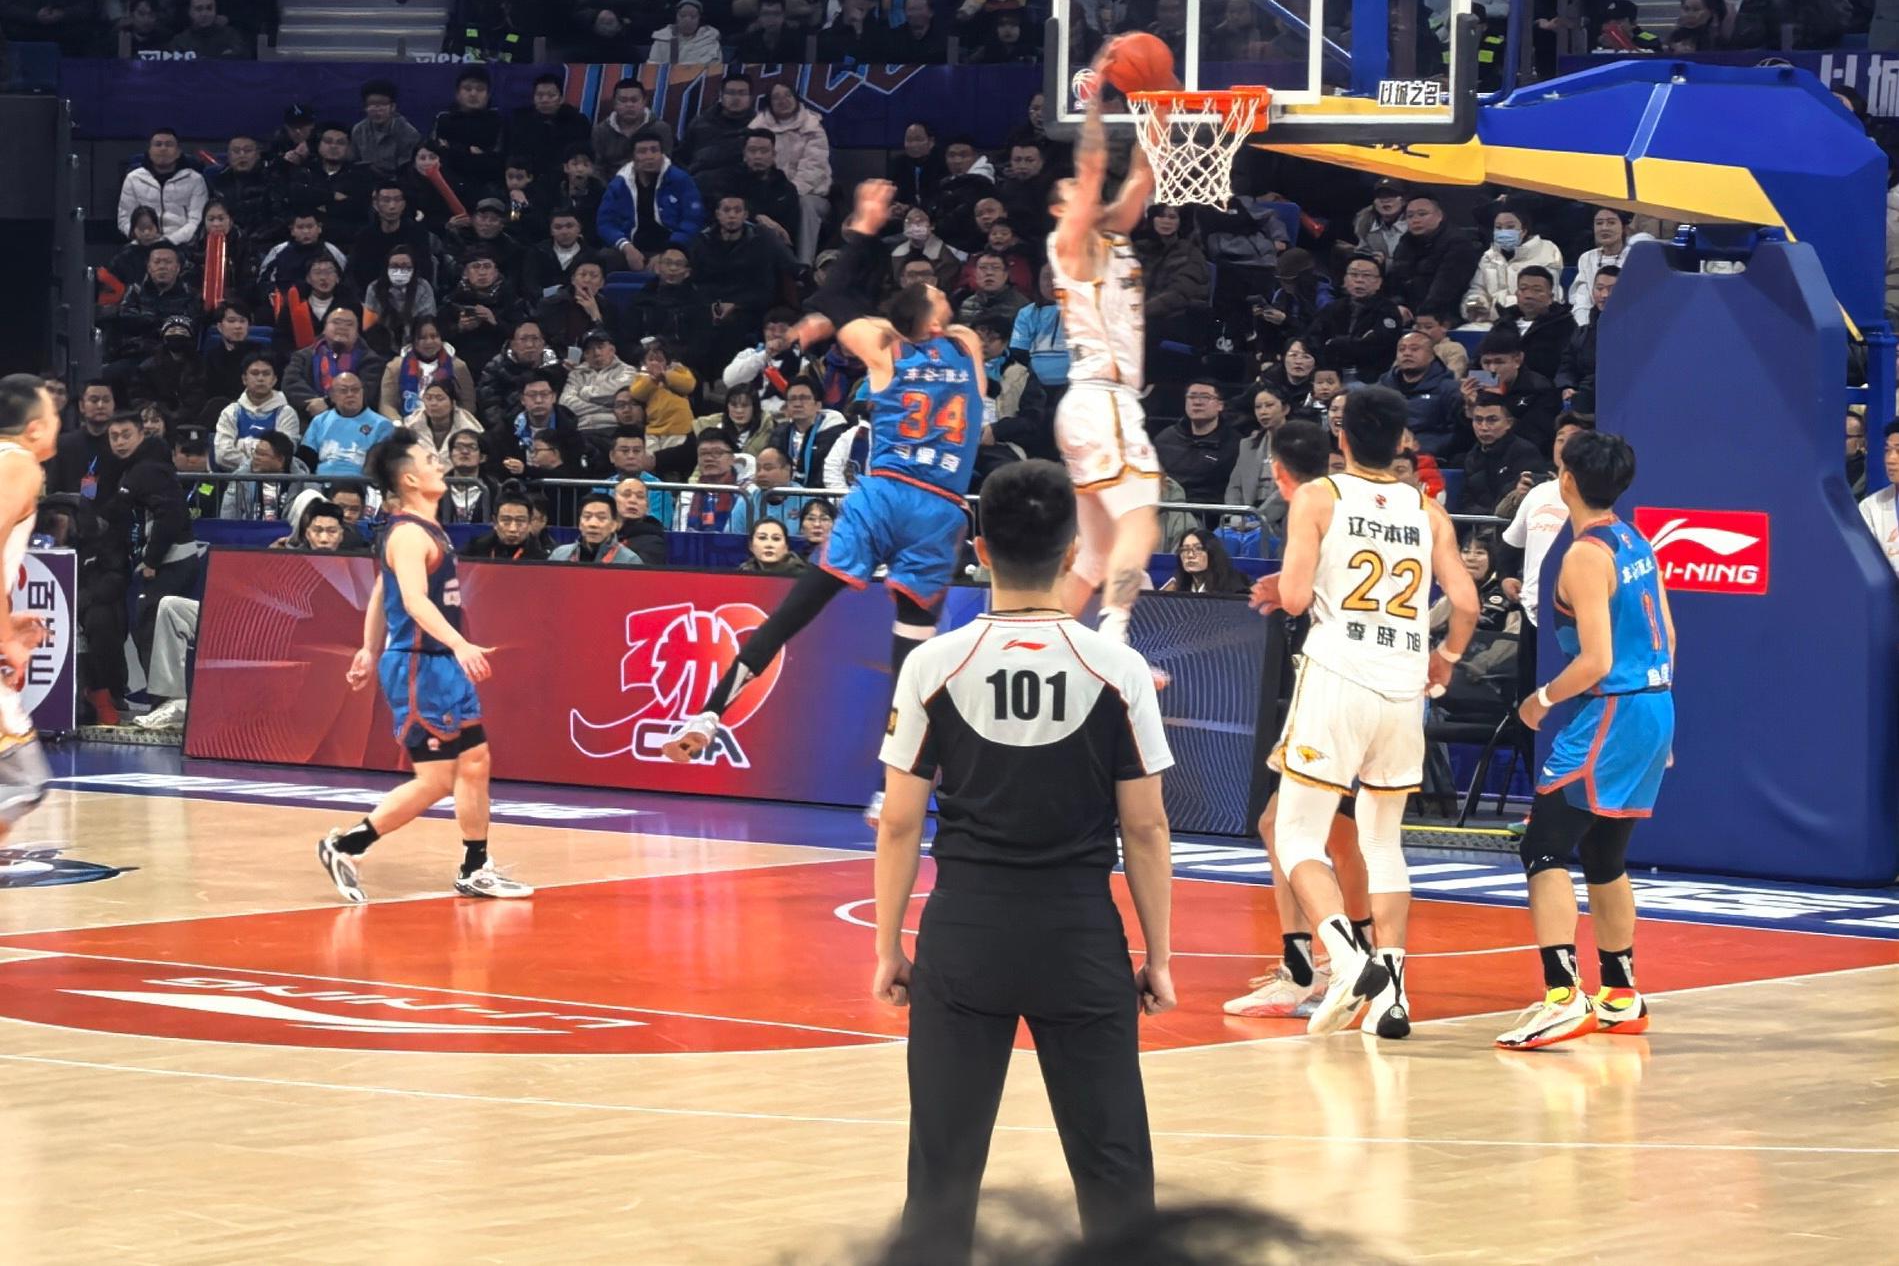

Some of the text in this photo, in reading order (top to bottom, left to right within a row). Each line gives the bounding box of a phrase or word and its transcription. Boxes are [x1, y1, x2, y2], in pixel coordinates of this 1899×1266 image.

[1379, 80, 1440, 107] 以城之名
[898, 390, 968, 447] 34
[1347, 516, 1421, 547] 辽宁本钢
[1341, 549, 1423, 621] 22
[1663, 561, 1761, 585] I-NING
[985, 668, 1068, 722] 101
[633, 719, 751, 769] CA
